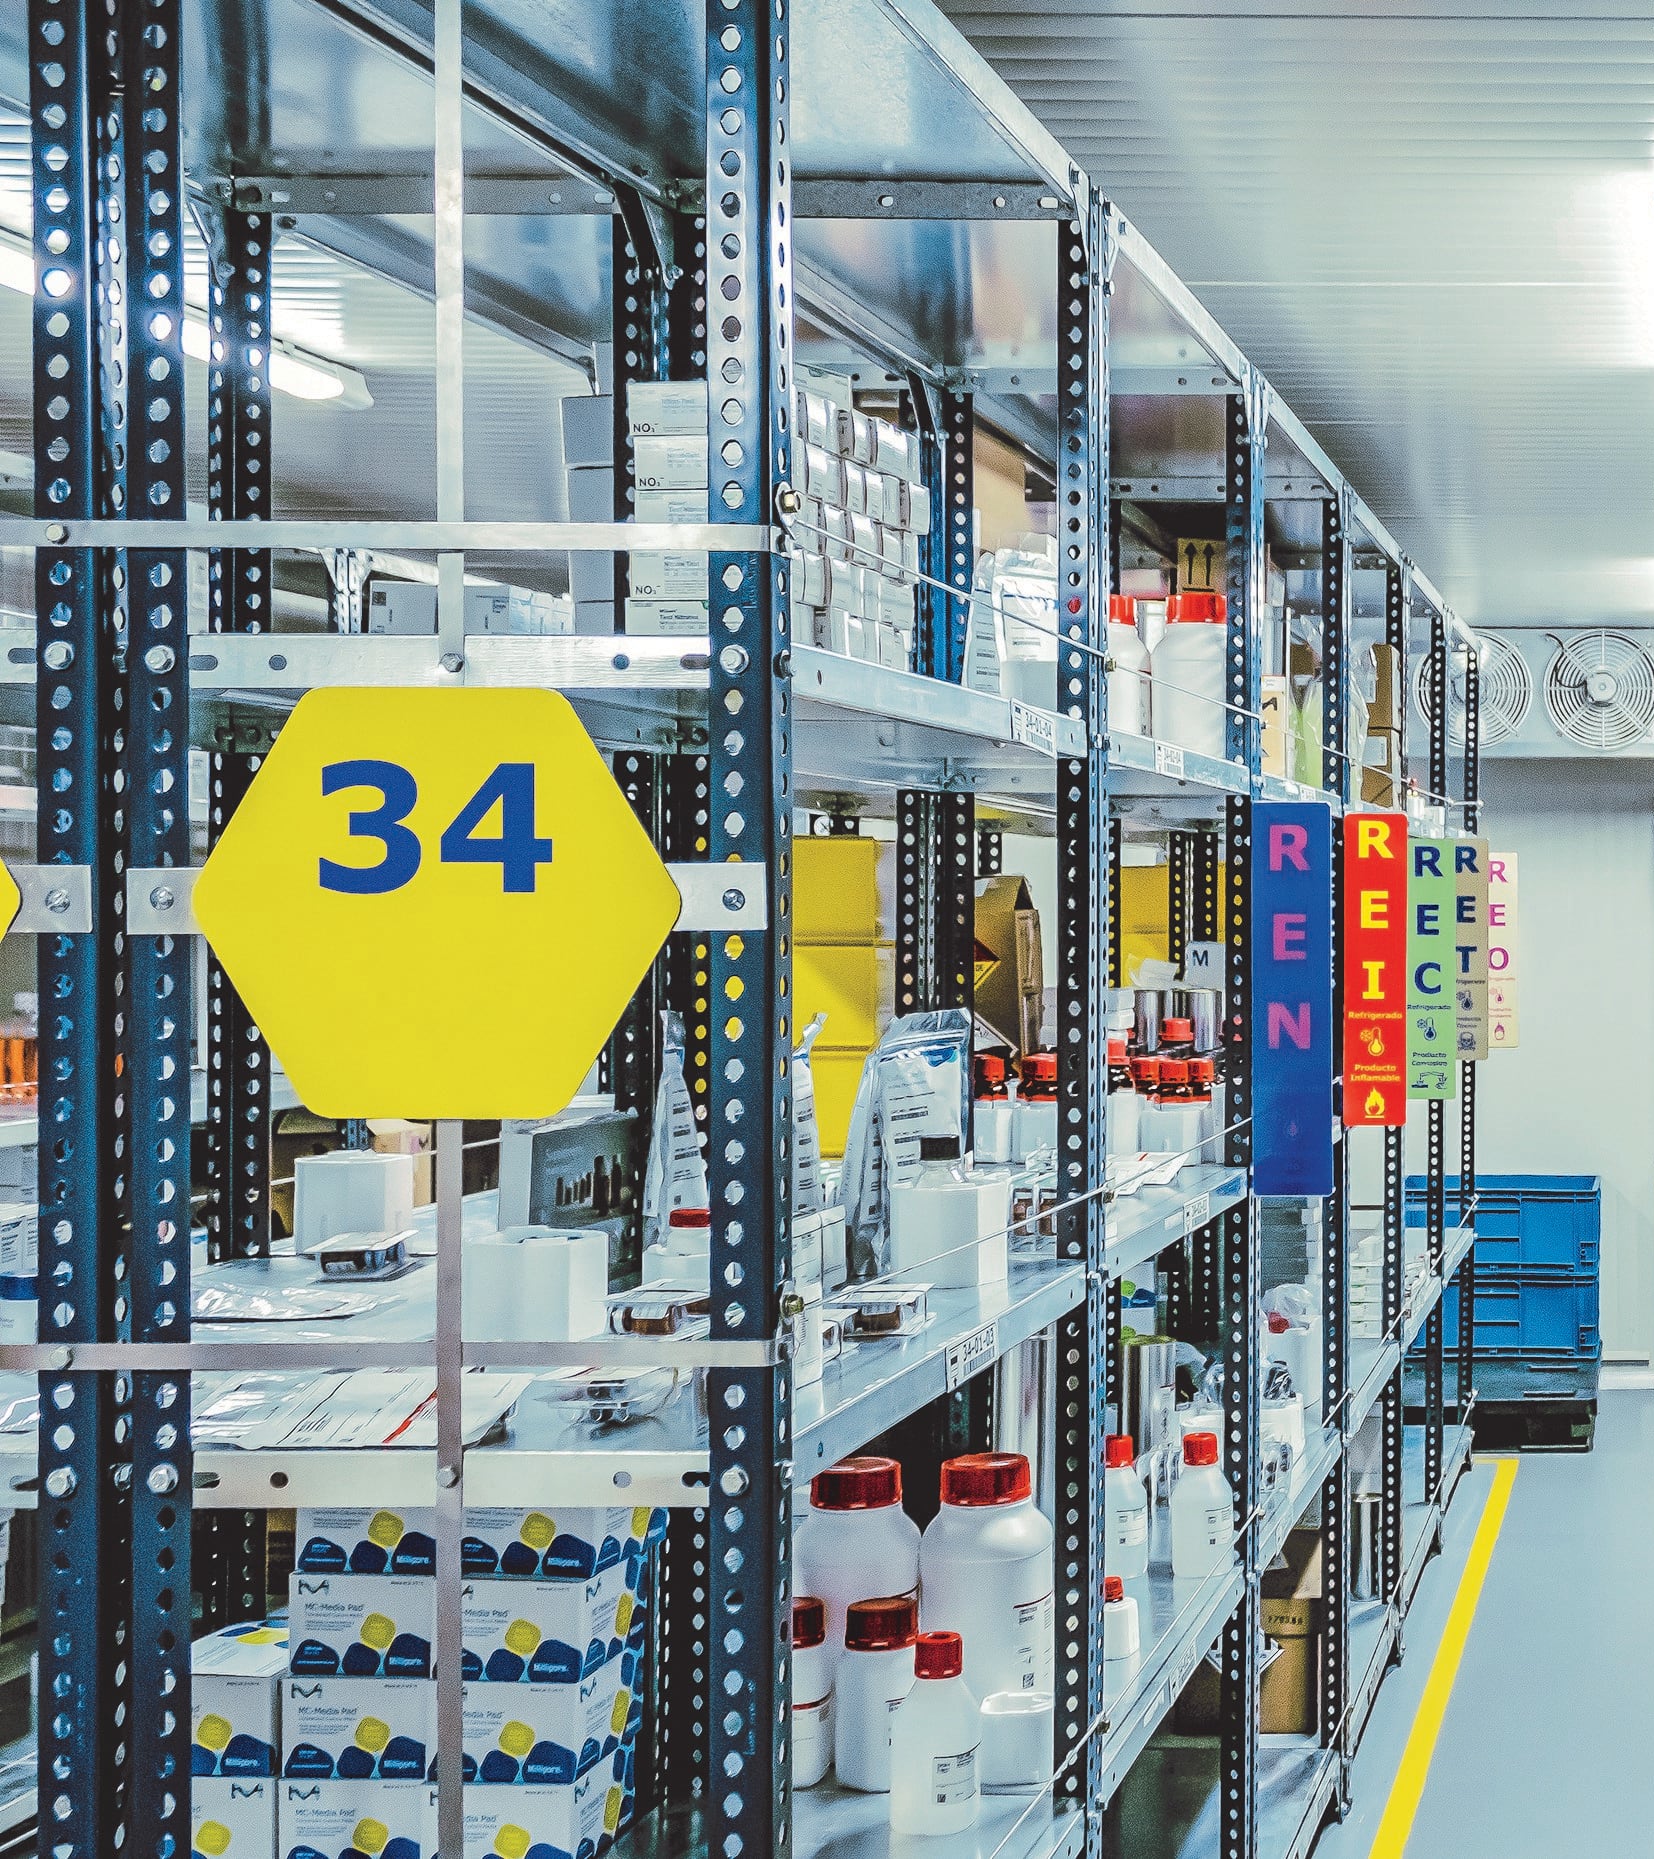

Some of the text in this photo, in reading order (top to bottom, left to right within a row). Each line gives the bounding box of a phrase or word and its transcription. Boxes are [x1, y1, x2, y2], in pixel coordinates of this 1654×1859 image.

[318, 759, 554, 895] 34
[1266, 823, 1312, 1050] REN
[1357, 819, 1395, 1000] REI
[1414, 845, 1443, 995] REC
[1347, 1011, 1403, 1021] Refrigerado
[1350, 1073, 1401, 1082] Inflamable
[1354, 1063, 1397, 1072] Producto
